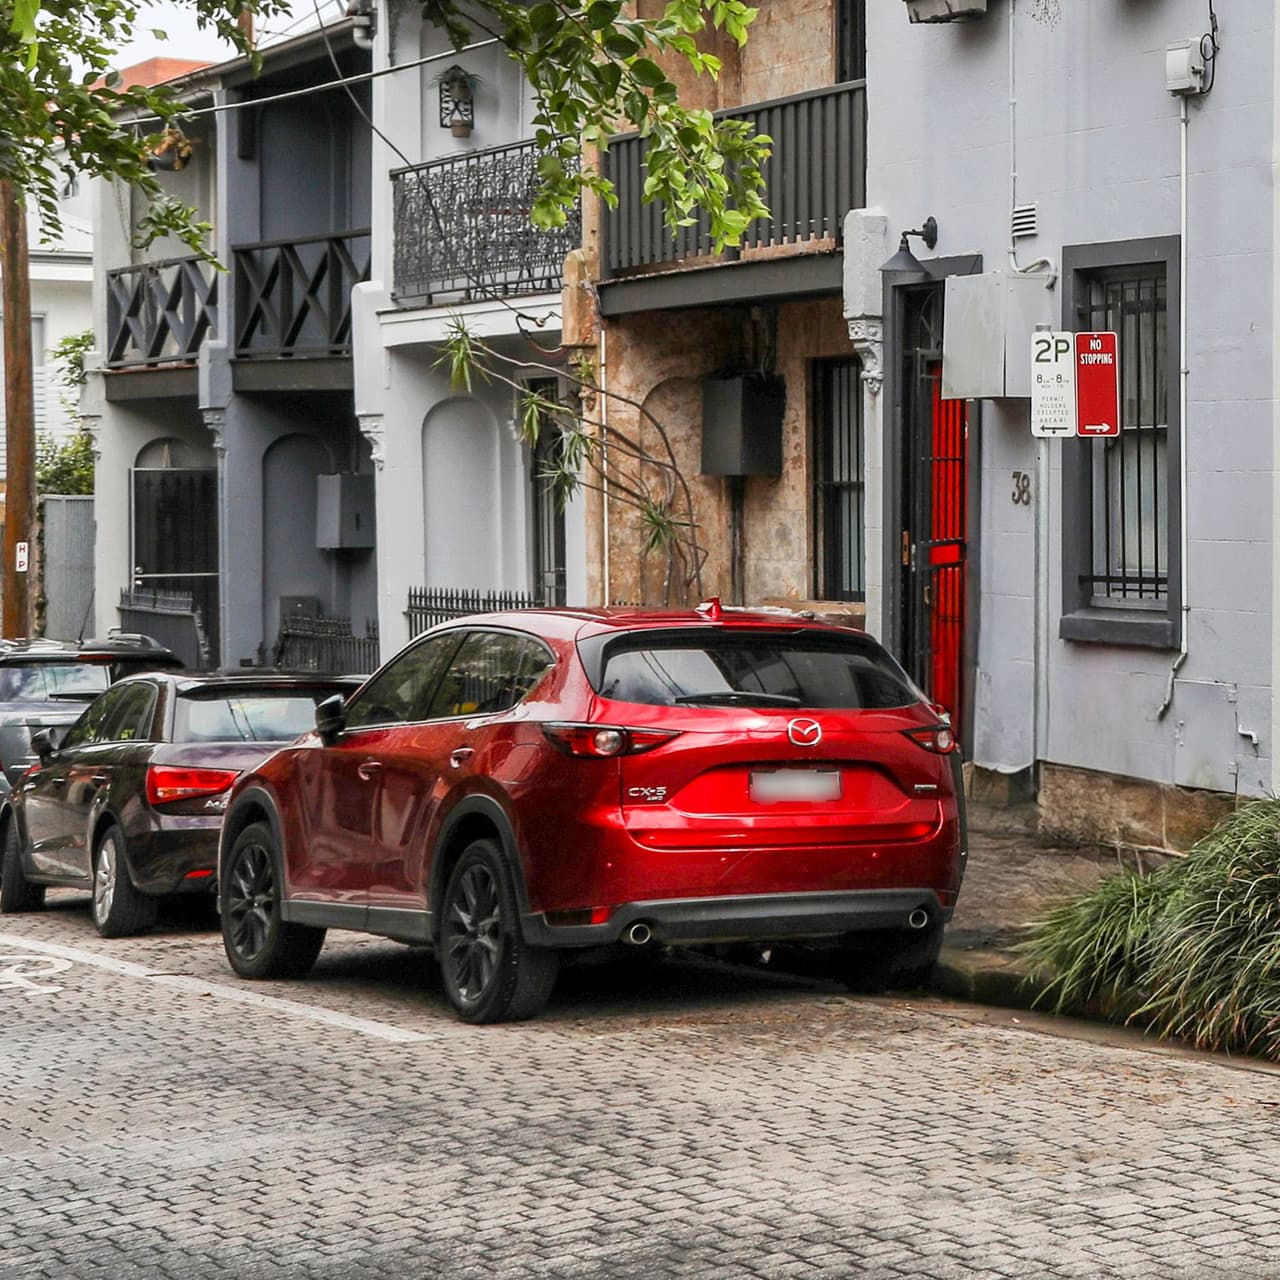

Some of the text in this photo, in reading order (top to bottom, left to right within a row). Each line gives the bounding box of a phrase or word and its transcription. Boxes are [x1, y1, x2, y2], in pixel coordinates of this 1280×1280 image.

[1035, 339, 1070, 363] 2P
[1090, 339, 1102, 351] NO
[1080, 353, 1113, 365] STOPPING
[1012, 471, 1031, 506] 38
[629, 786, 667, 797] CX-5
